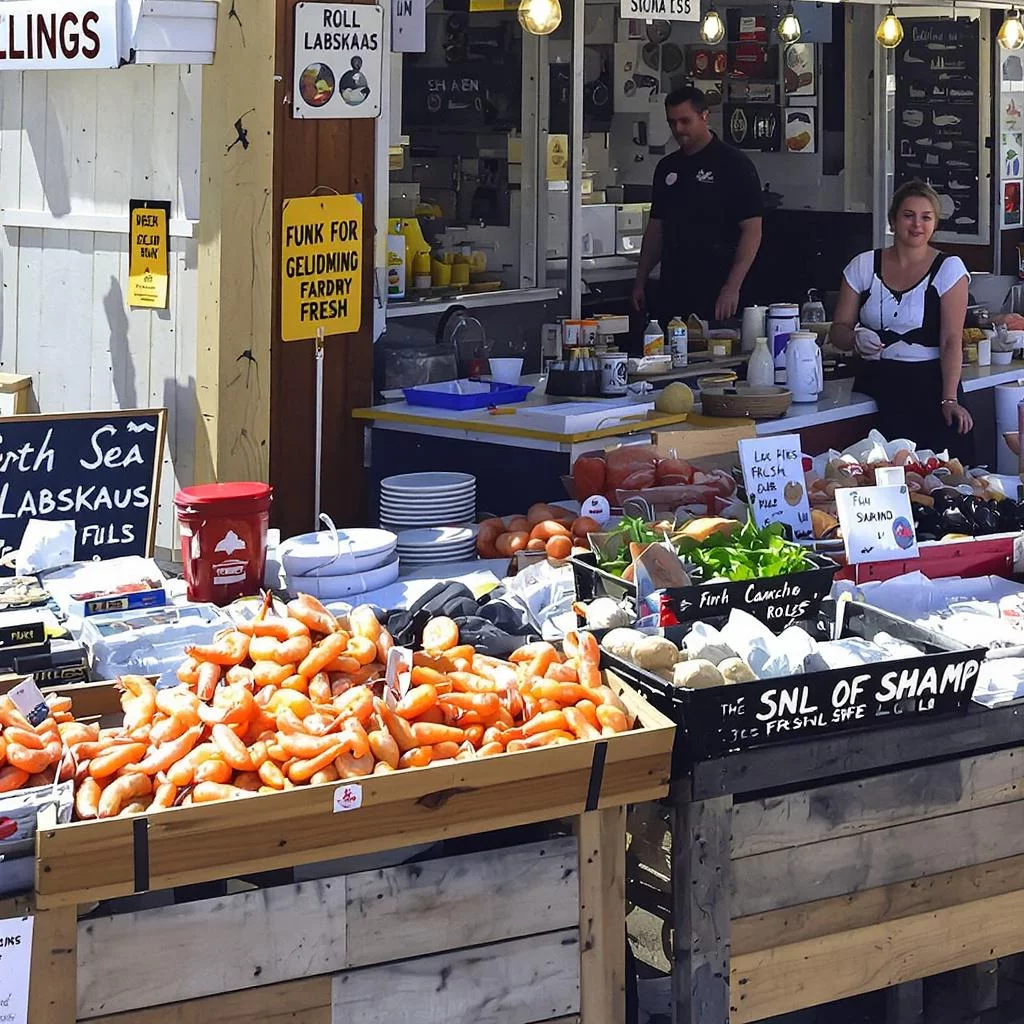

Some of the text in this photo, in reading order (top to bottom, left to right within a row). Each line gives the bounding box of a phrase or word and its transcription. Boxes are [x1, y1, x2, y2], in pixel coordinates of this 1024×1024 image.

[323, 9, 361, 28] ROLL
[304, 32, 378, 51] LABSKAAS
[286, 220, 358, 248] FUNK FOR
[300, 299, 348, 322] FRESH
[0, 428, 55, 473] rth
[0, 482, 150, 519] LABSKAUS
[756, 686, 818, 722] SNL
[831, 674, 872, 707] OF
[874, 659, 981, 703] SHAMP
